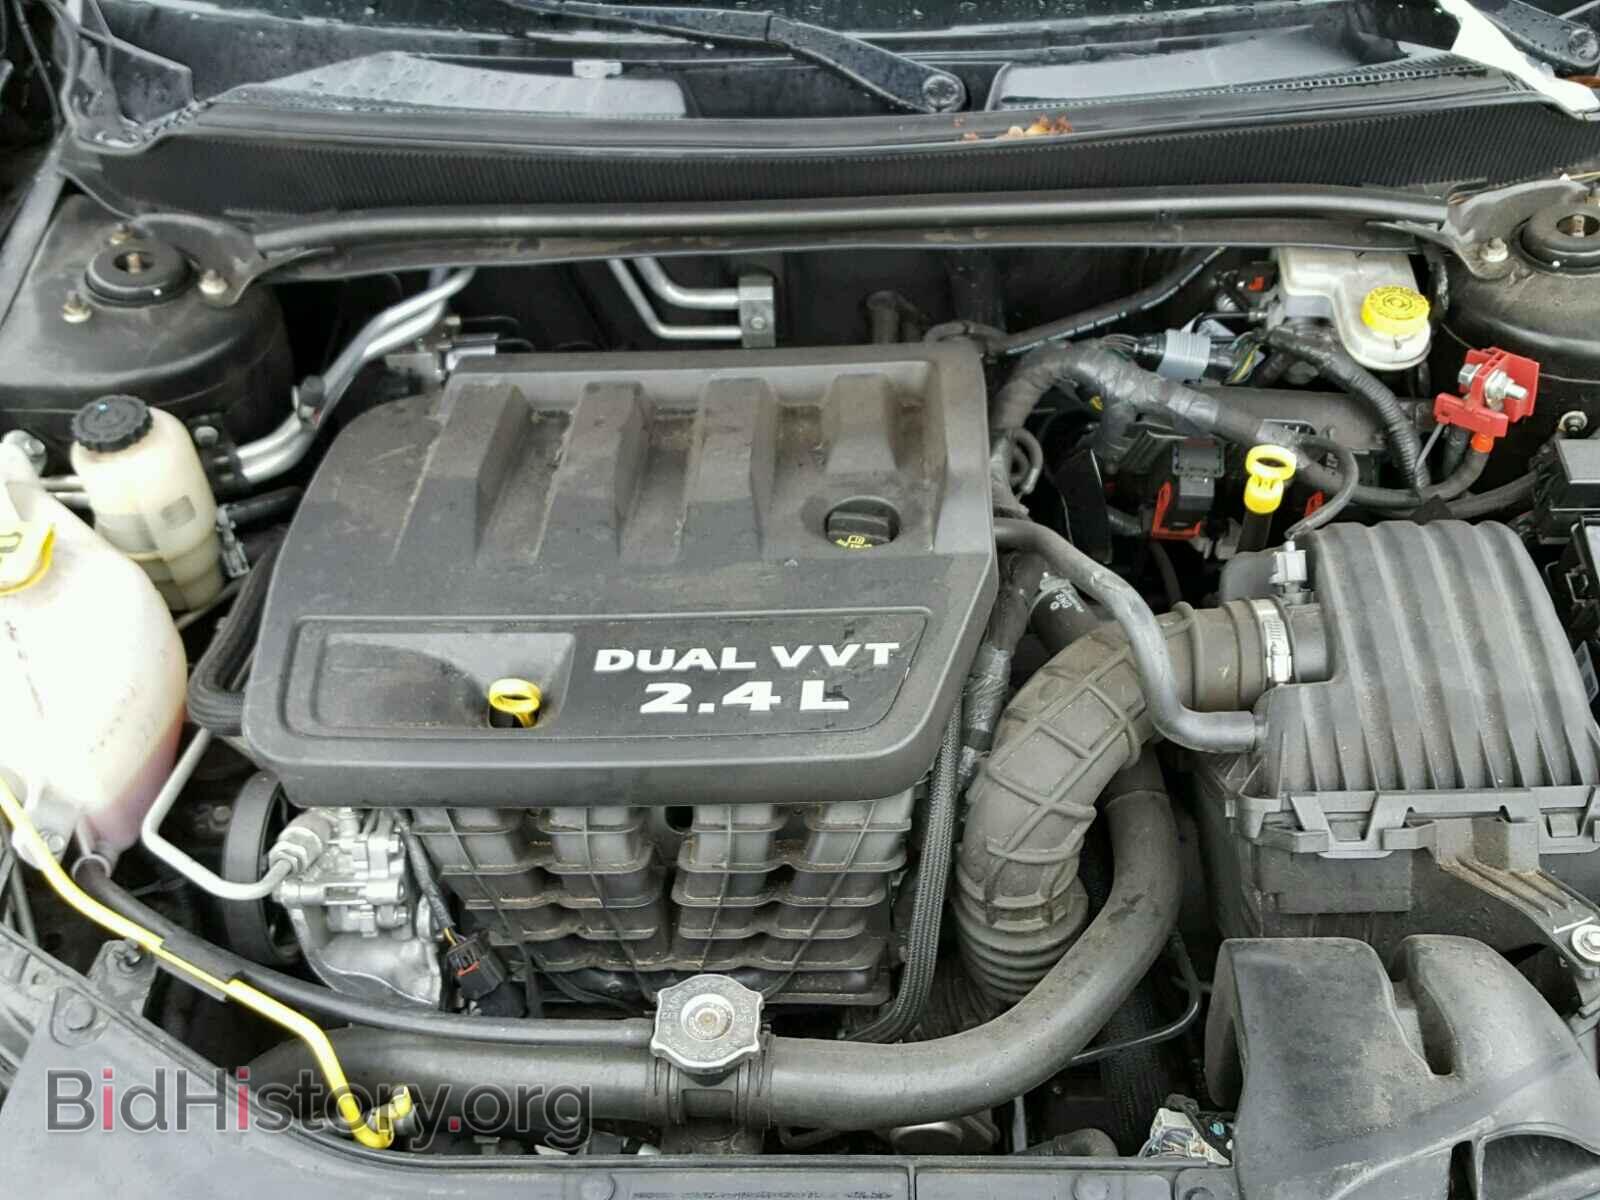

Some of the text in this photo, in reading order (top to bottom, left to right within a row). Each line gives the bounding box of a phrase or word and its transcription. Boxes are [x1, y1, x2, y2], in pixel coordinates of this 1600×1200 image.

[594, 642, 900, 672] DUAL VVT
[640, 681, 782, 713] 2.4
